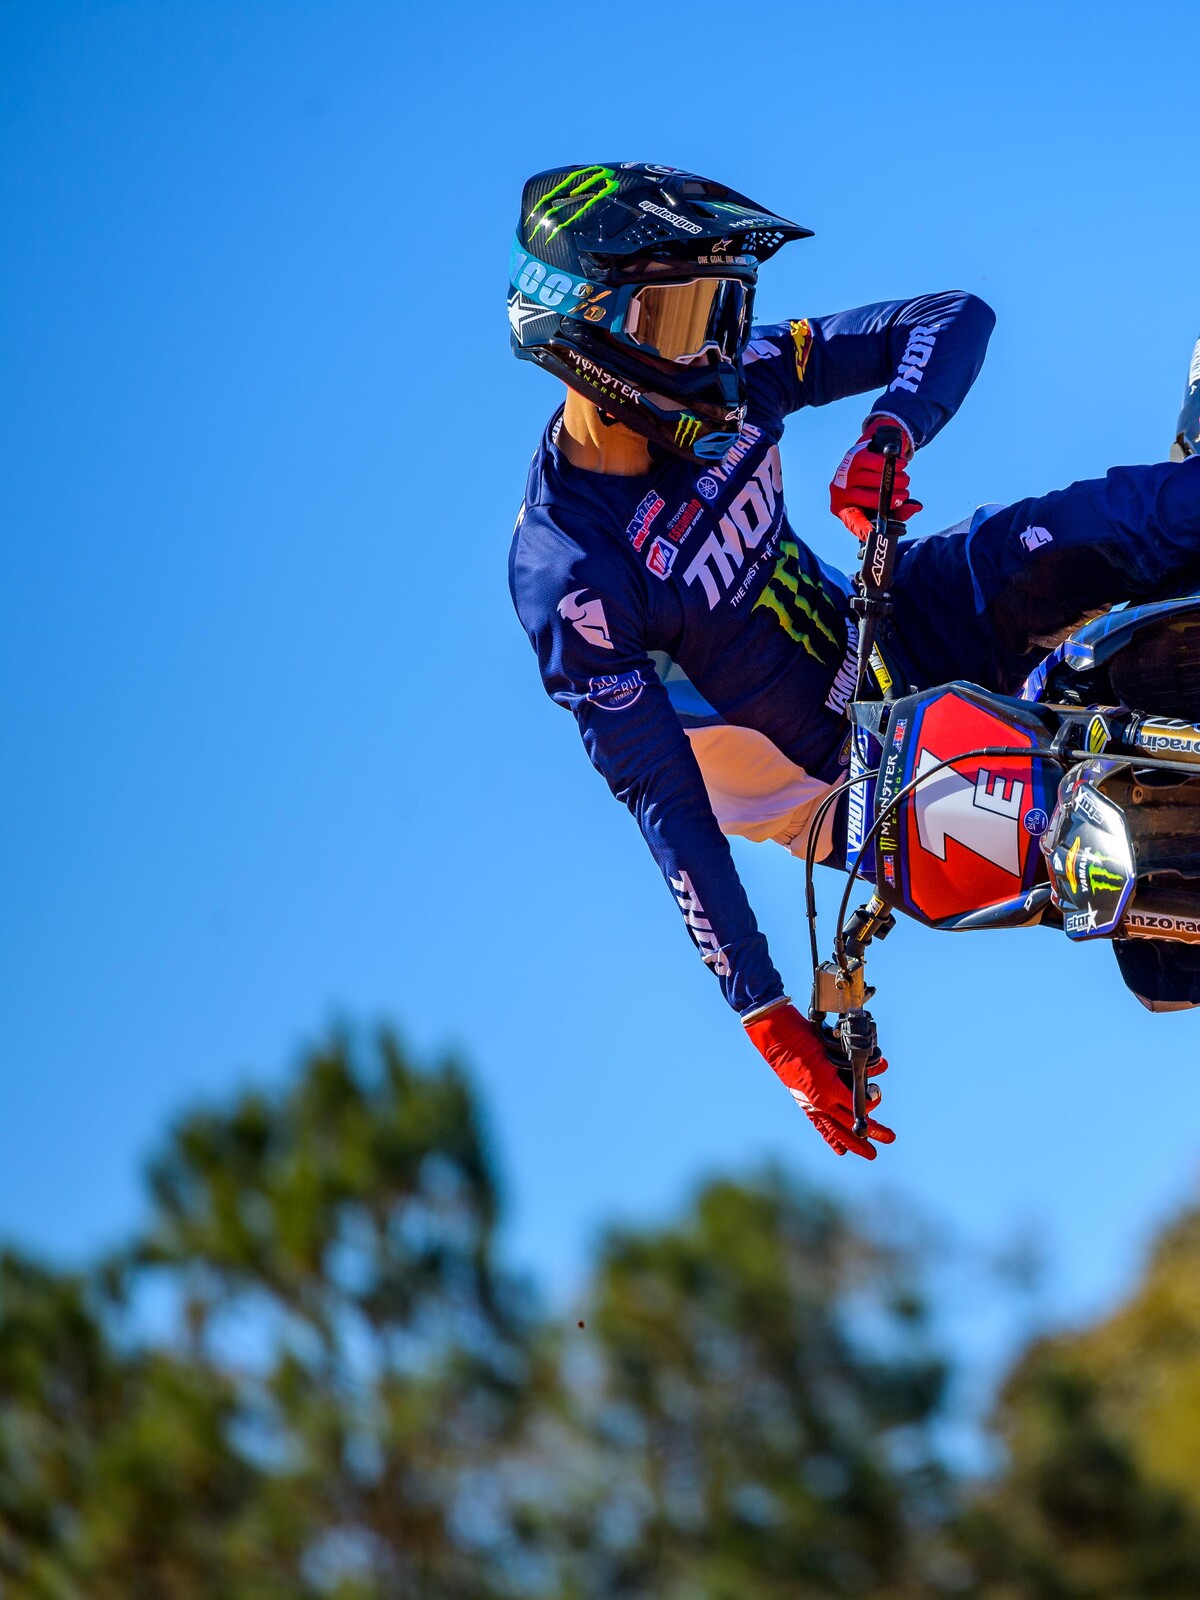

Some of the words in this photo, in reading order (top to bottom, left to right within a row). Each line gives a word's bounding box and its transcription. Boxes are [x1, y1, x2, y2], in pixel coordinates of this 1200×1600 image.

[638, 200, 703, 234] apdesigns
[511, 252, 614, 322] 100%
[569, 349, 642, 405] MONSTER
[575, 367, 626, 404] ENERGY
[668, 499, 701, 543] ESCONDIDO
[672, 501, 689, 523] TOYOTA
[873, 534, 889, 587] ARC
[730, 585, 746, 608] THE
[742, 562, 761, 590] FIRST
[892, 718, 908, 752] AMA
[892, 766, 902, 825] ENRGY
[884, 854, 897, 890] AMA
[1081, 846, 1092, 893] YAMAHA
[1066, 913, 1091, 932] star
[1124, 912, 1174, 930] enzo
